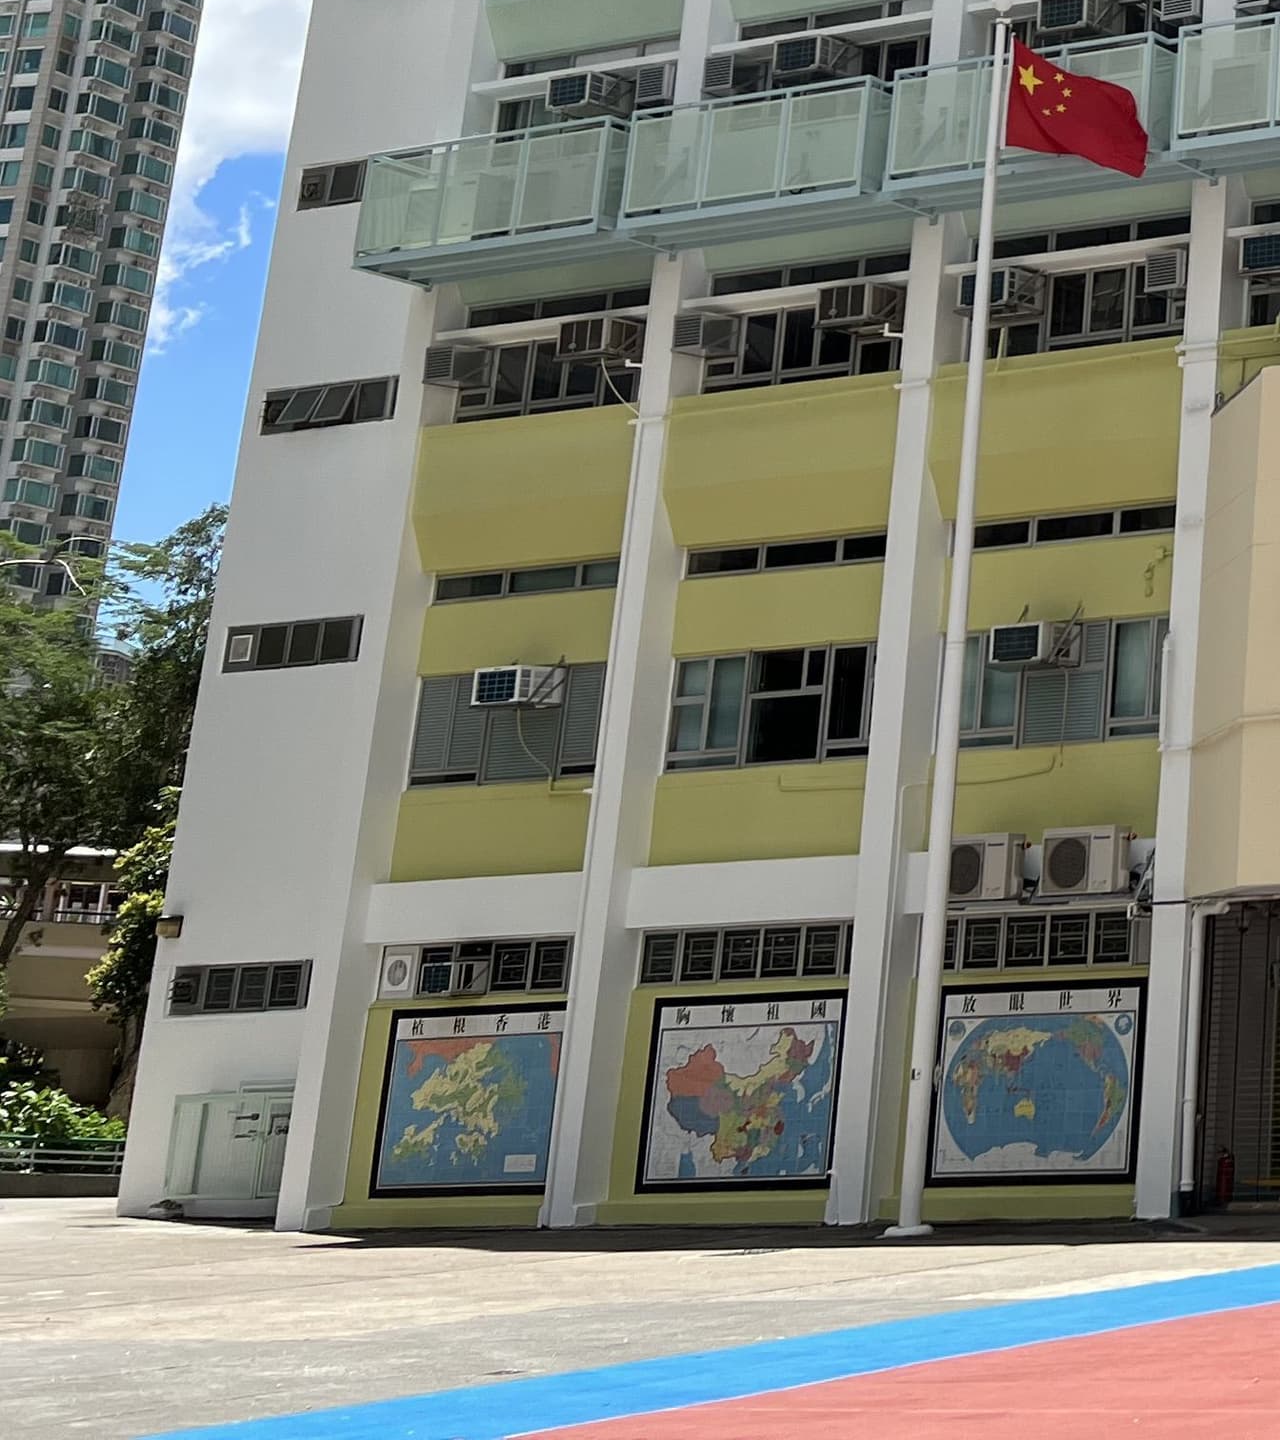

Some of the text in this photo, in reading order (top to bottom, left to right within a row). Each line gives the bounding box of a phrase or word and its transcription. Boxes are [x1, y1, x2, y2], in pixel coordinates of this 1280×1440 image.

[676, 1000, 828, 1026] 胸懷祖國
[962, 989, 1122, 1014] 放眼世界
[411, 1013, 552, 1037] 植根香港
